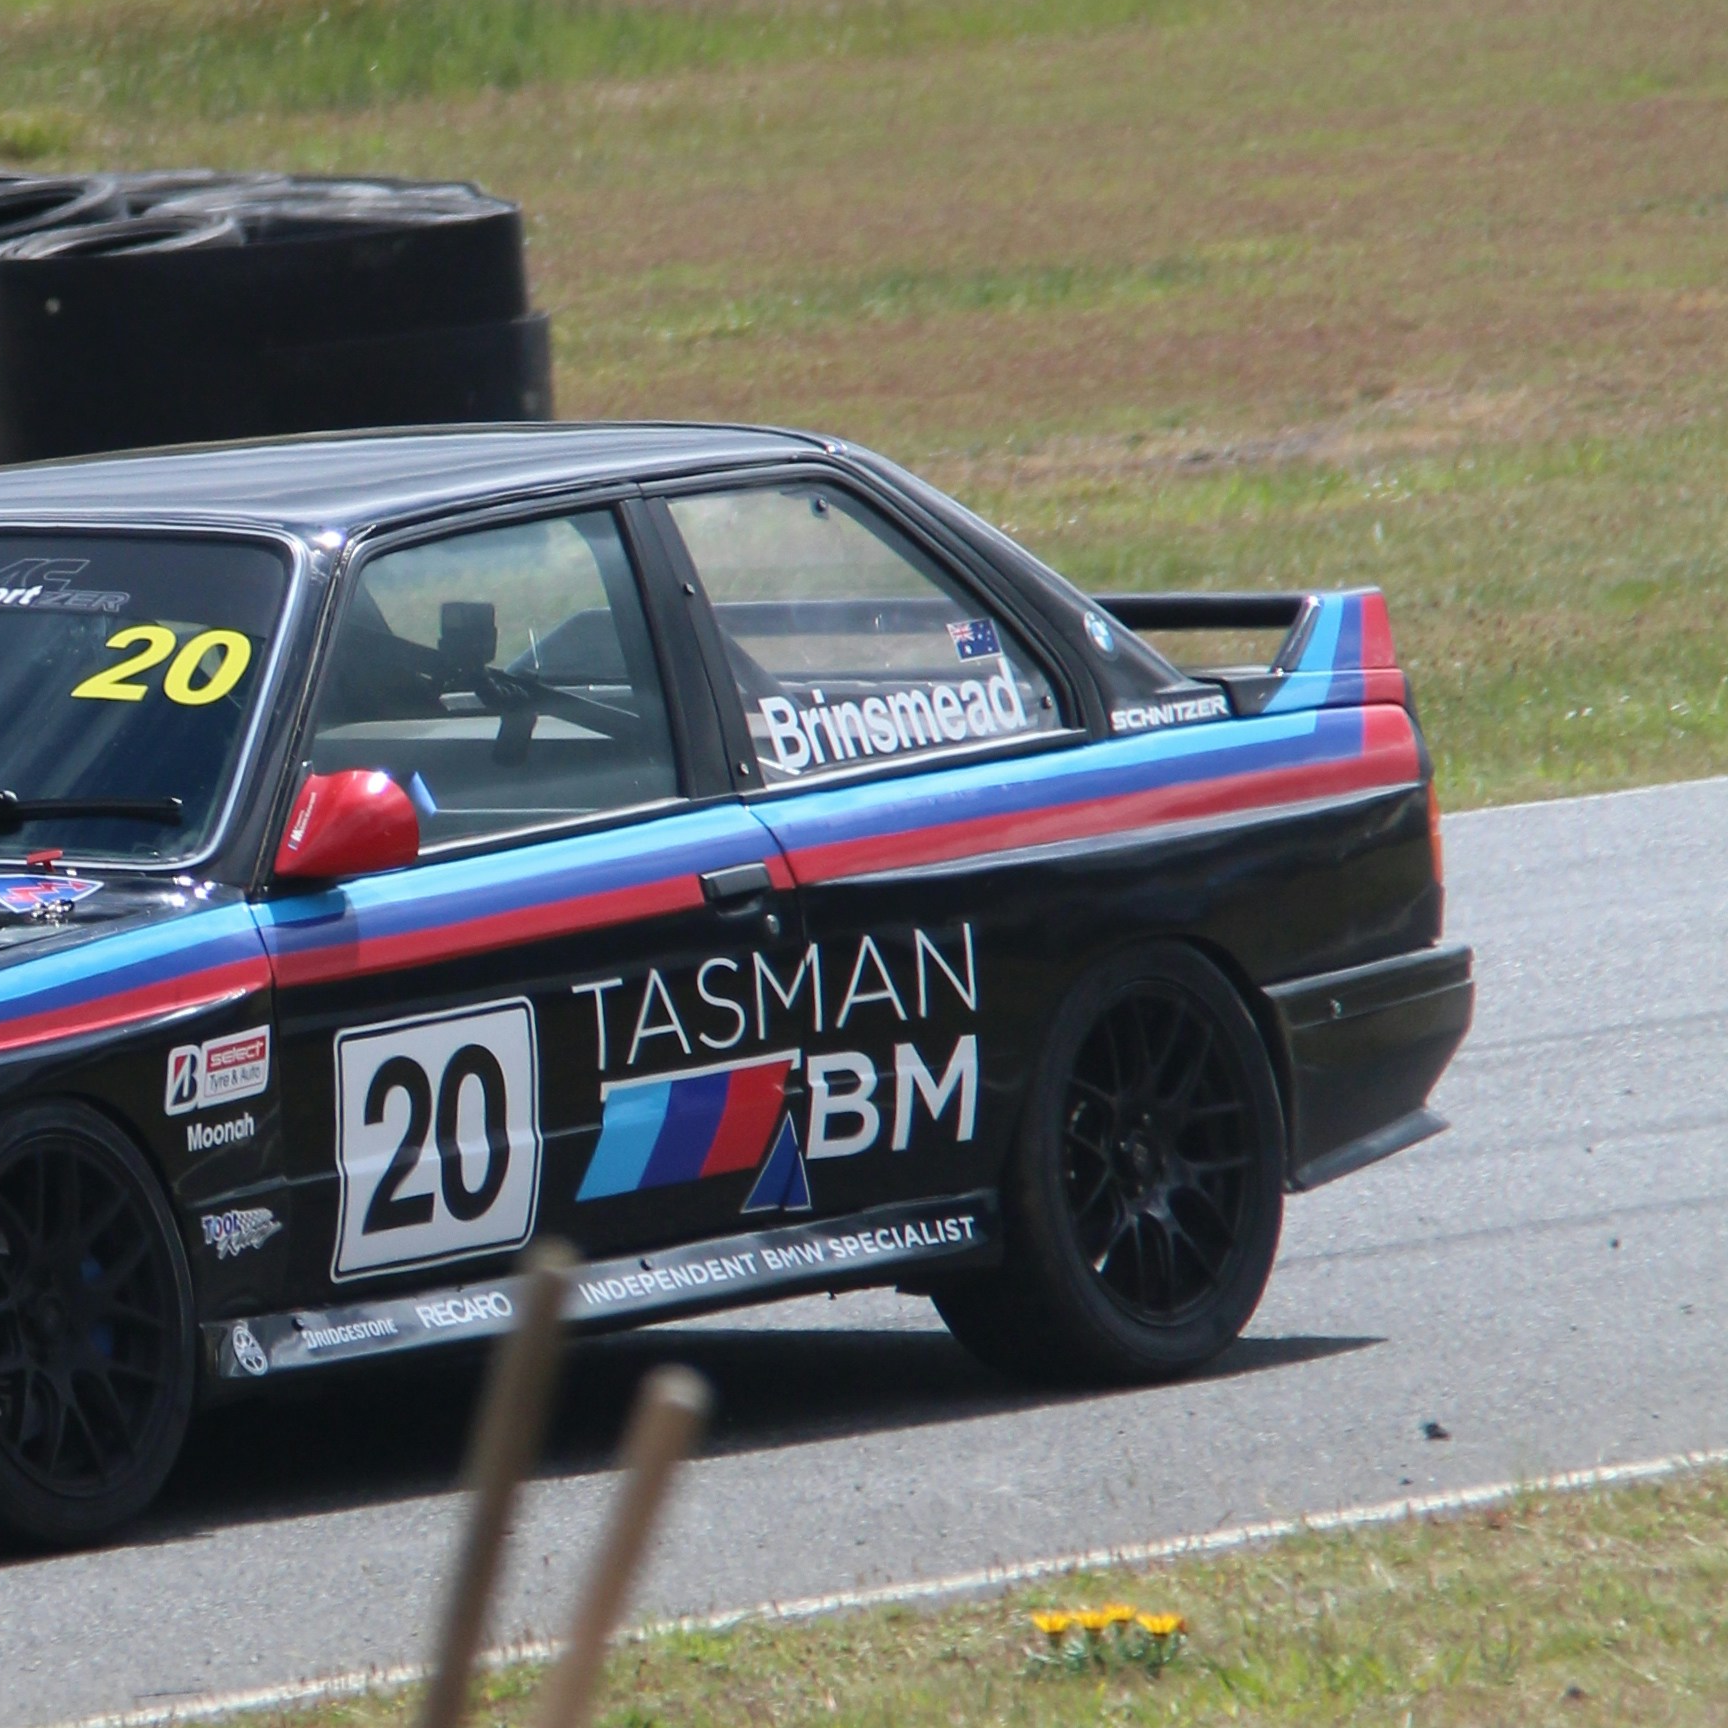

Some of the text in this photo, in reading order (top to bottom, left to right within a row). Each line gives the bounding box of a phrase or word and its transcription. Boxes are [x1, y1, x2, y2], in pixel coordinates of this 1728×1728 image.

[70, 624, 253, 706] 20
[758, 656, 1028, 770] Brinsmead
[1110, 694, 1230, 732] SCHNITZER
[571, 922, 978, 1071] TASMAN
[210, 1040, 266, 1069] select
[209, 1071, 231, 1094] Tyre
[241, 1065, 262, 1082] Auto
[186, 1111, 255, 1152] Moonah
[362, 1043, 511, 1236] 20
[577, 1216, 976, 1305] INDEPENDENT BMW SPECIALIST
[414, 1291, 514, 1330] RECARO
[301, 1317, 399, 1351] BRIDGESTONE
